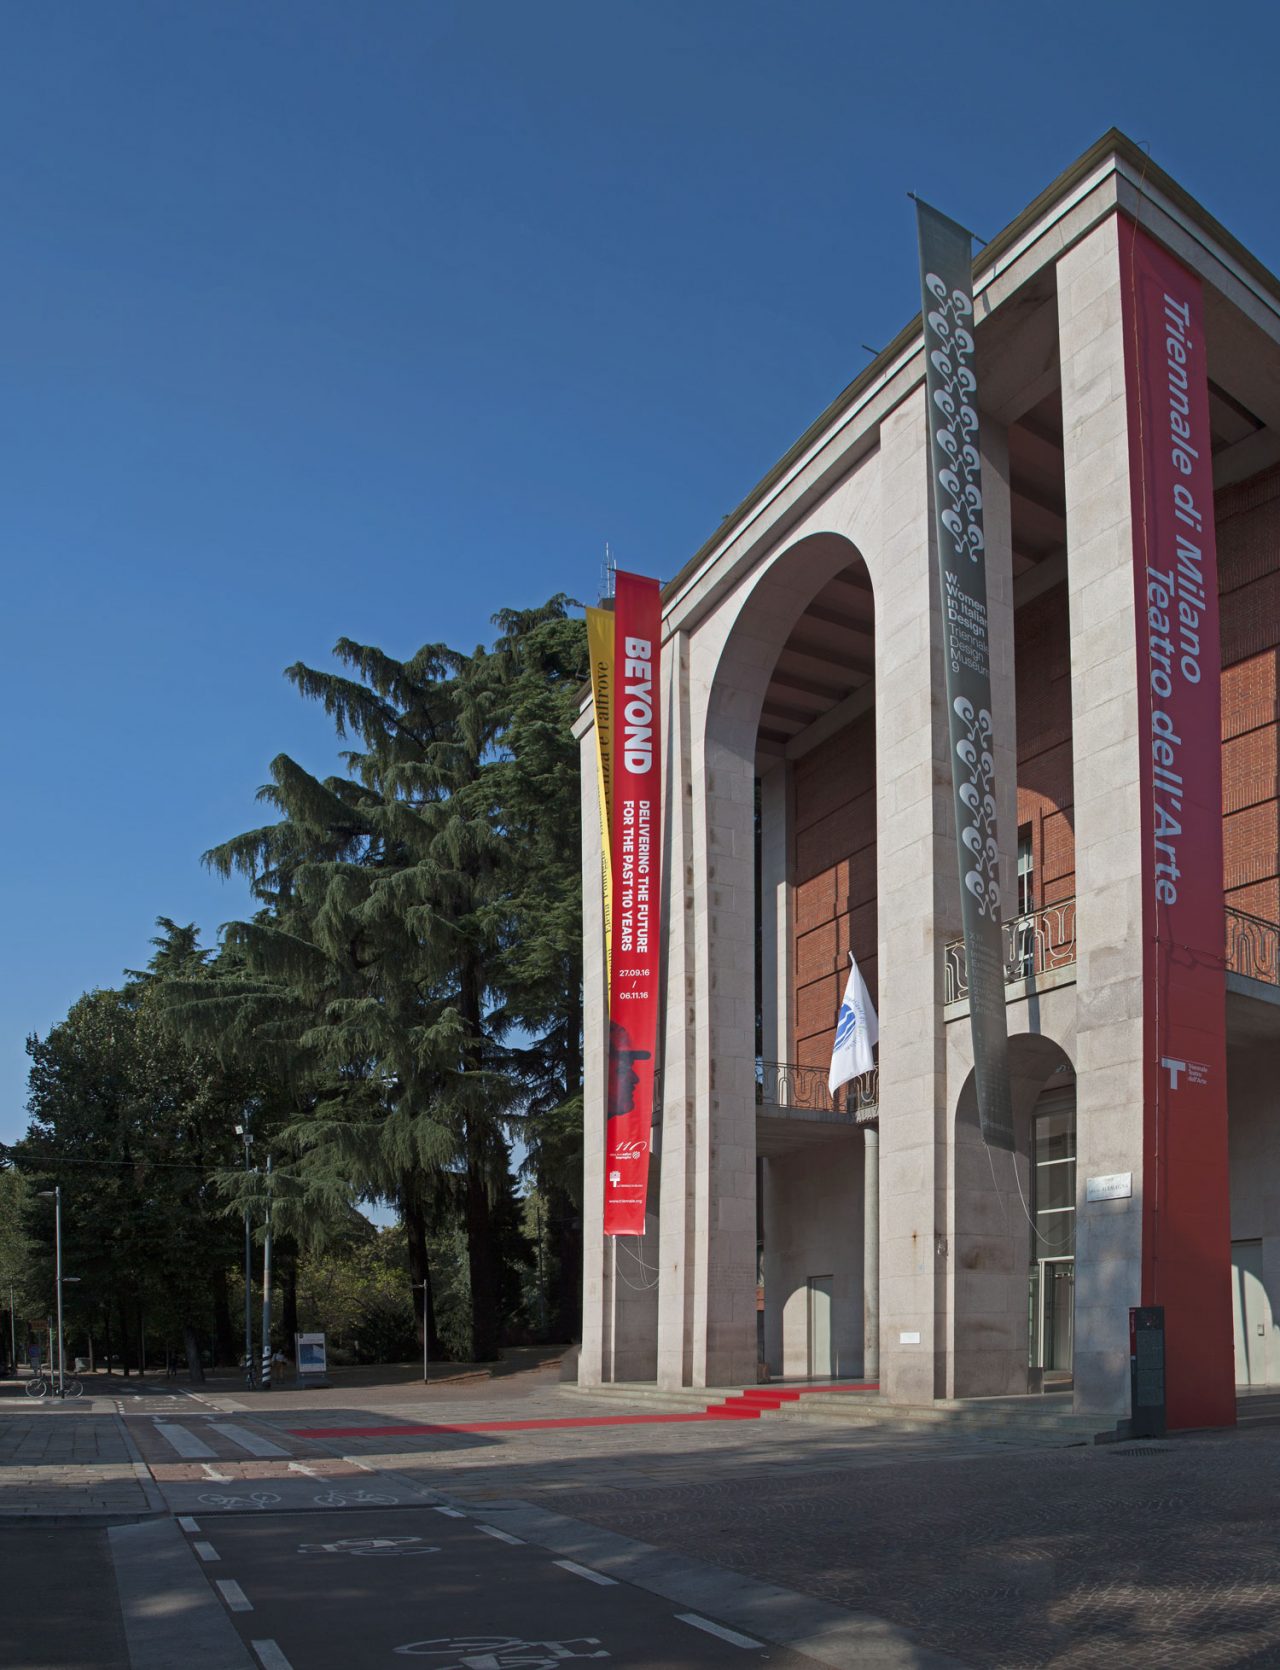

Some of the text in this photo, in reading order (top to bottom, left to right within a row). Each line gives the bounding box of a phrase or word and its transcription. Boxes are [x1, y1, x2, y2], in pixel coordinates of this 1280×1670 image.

[1164, 293, 1206, 684] Triennale di Milano
[945, 583, 986, 615] Women
[947, 595, 959, 610] in
[948, 608, 985, 637] Design
[950, 635, 984, 662] Design
[951, 660, 960, 673] 9
[624, 636, 652, 775] BEYOND
[1146, 566, 1183, 906] Teatro dell'Arte
[621, 800, 635, 951] FOR THE PAST 110 YEARS
[636, 800, 650, 953] DELIVERING THE FUTURE
[619, 969, 650, 977] 27.09.16
